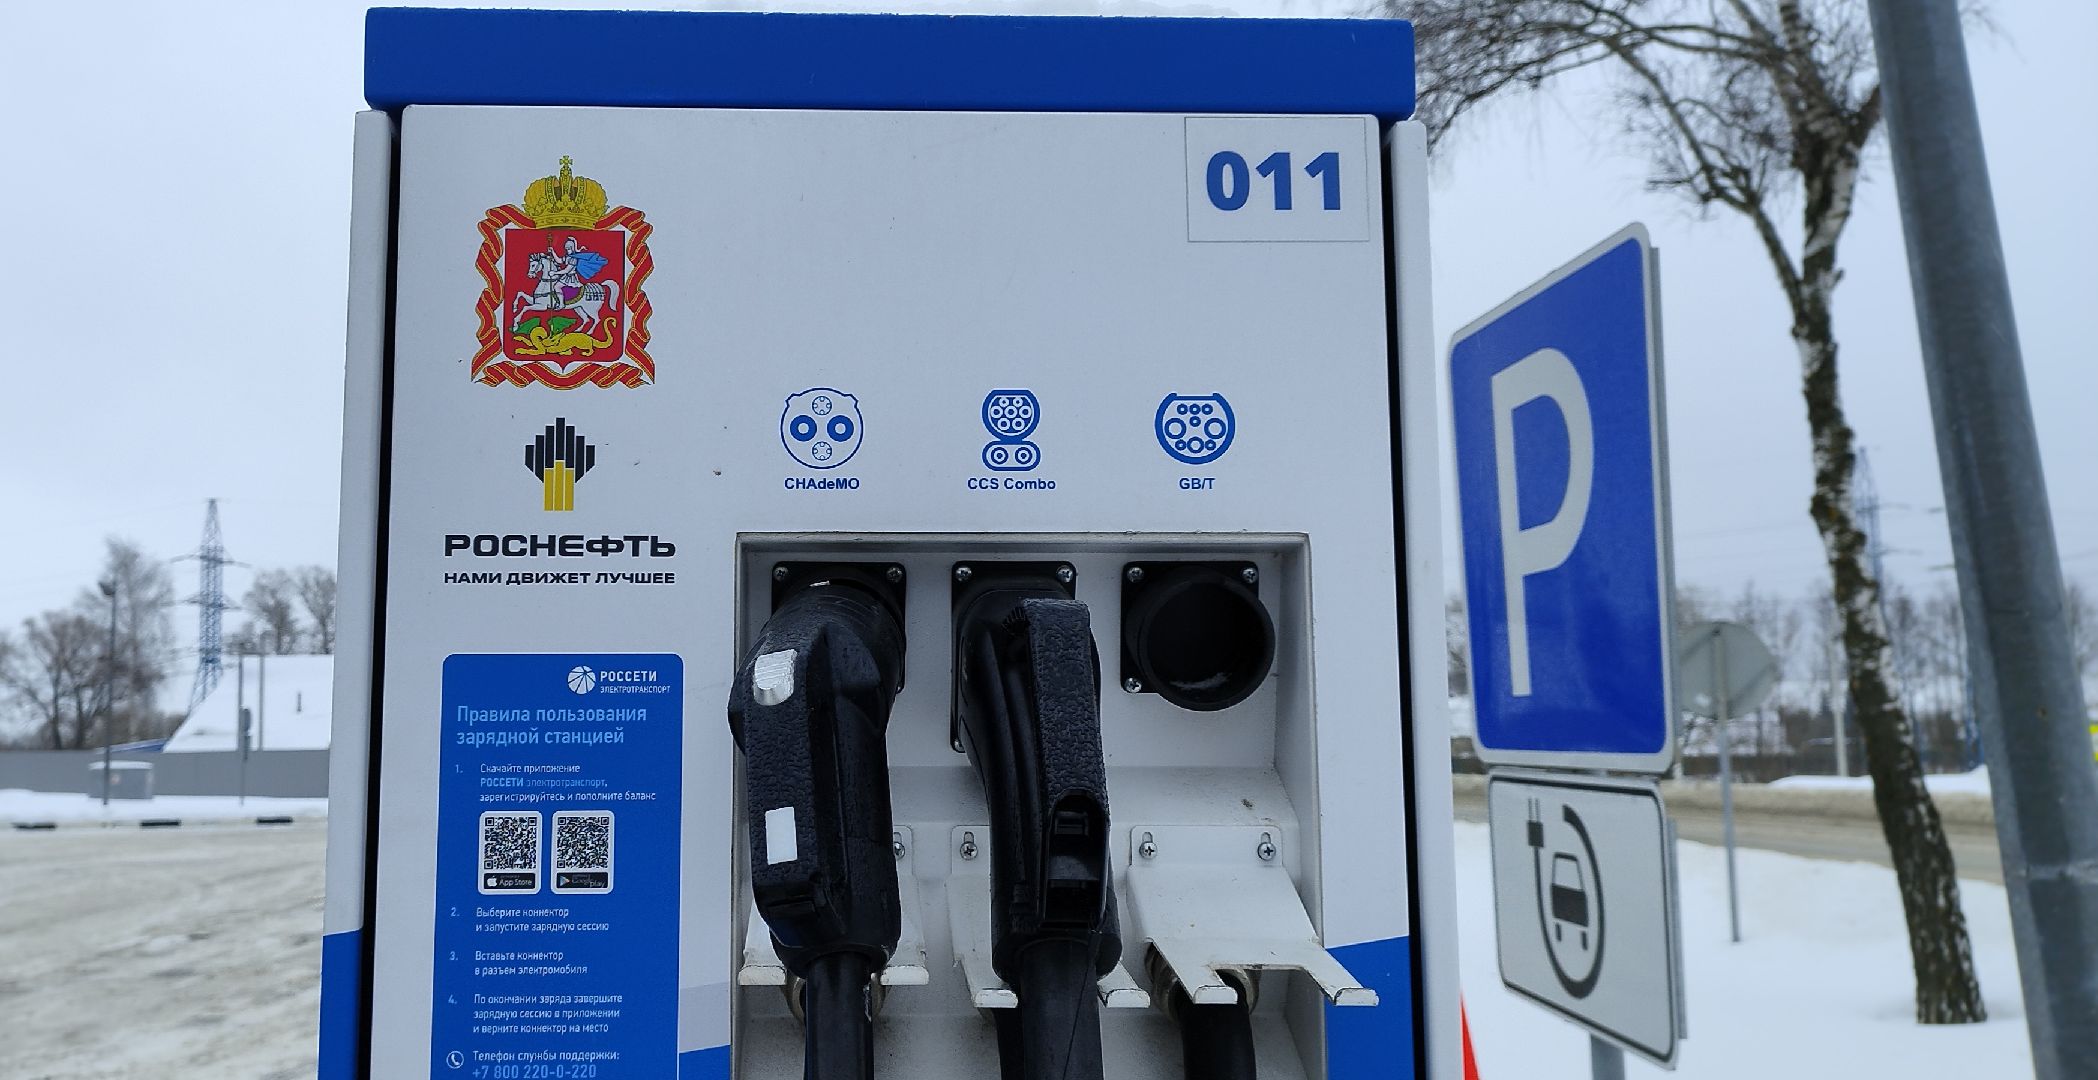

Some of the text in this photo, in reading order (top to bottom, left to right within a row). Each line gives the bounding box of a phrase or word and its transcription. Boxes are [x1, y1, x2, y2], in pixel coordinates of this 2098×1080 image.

[1206, 150, 1341, 211] 011
[784, 477, 860, 491] CHAdeMO
[967, 477, 1056, 491] CCS Combo
[1179, 477, 1215, 491] GB/T
[1491, 346, 1595, 696] P
[444, 535, 676, 557] РОСНЕФТЬ
[444, 572, 675, 585] НАМИ ДВИЖЕТ ЛУЧШЕЕ
[600, 671, 657, 682] РОССЕТИ
[457, 705, 647, 726] Правила пользования
[456, 726, 624, 748] зарядной станцией
[455, 764, 463, 773] 1.
[480, 764, 580, 774] Скачайте приложение
[480, 778, 608, 788] РОССЕТИ электротранспорт,
[480, 791, 565, 803] зарегистрируйтесь
[576, 792, 622, 800] пополните
[625, 791, 656, 800] баланс
[451, 907, 460, 916] 2.
[477, 908, 569, 919] Выберите коннектор
[476, 922, 609, 933] и запустите зарядную сессию
[449, 952, 458, 960] 3.
[475, 952, 563, 962] Вставьте коннектор
[475, 965, 588, 977] в разъем электромобиля
[448, 995, 457, 1004] 4.
[474, 994, 622, 1005] По окончании заряда завершите
[474, 1009, 620, 1020] зарядную сессию в приложении
[473, 1024, 608, 1035] и верните коннектор на место
[473, 1051, 620, 1063] Телефон службы поддержки:
[472, 1065, 597, 1079] +7 800 220-0-220
